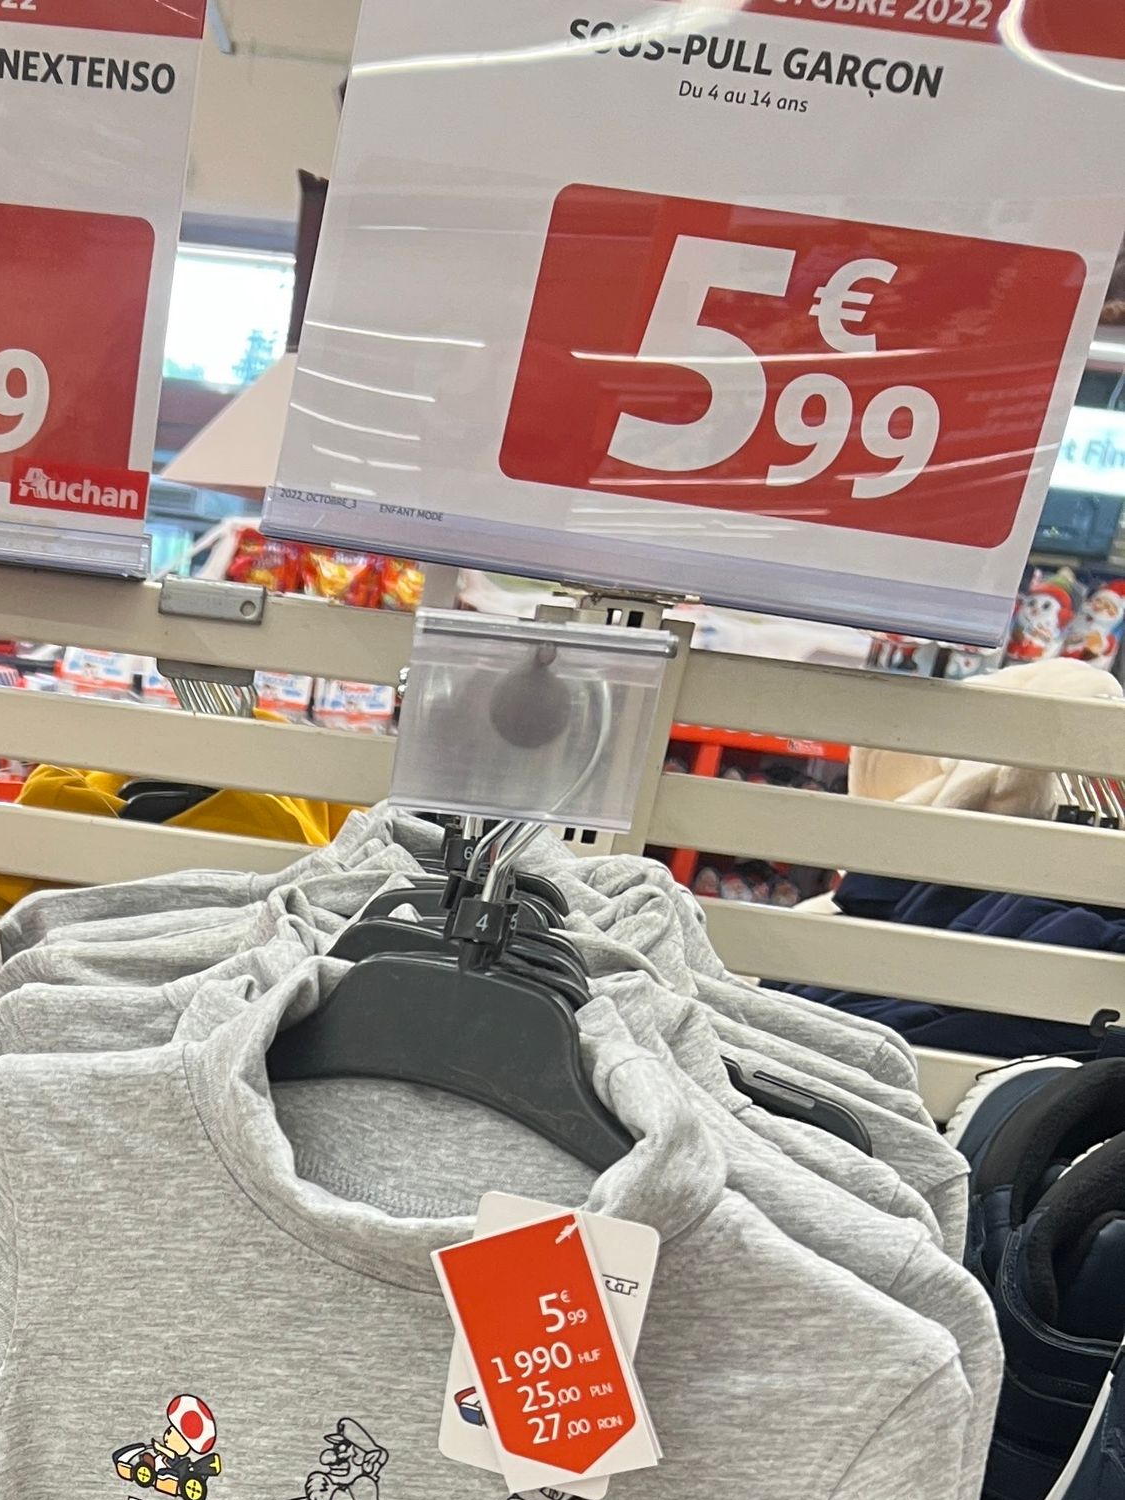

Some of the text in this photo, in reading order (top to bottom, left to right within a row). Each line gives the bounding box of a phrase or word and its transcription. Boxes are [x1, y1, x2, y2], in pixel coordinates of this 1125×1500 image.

[904, 0, 991, 30] 2022
[569, 18, 944, 98] SOUS-PULL GARÇON
[678, 79, 809, 113] Du 4 au 14 ans
[19, 467, 139, 510] Auchan
[379, 504, 415, 518] ENFANT
[416, 509, 444, 522] MODE
[475, 913, 489, 932] 4
[578, 1349, 601, 1365] HUF
[517, 1381, 613, 1413] 25,00 PLN
[597, 1415, 623, 1431] RON
